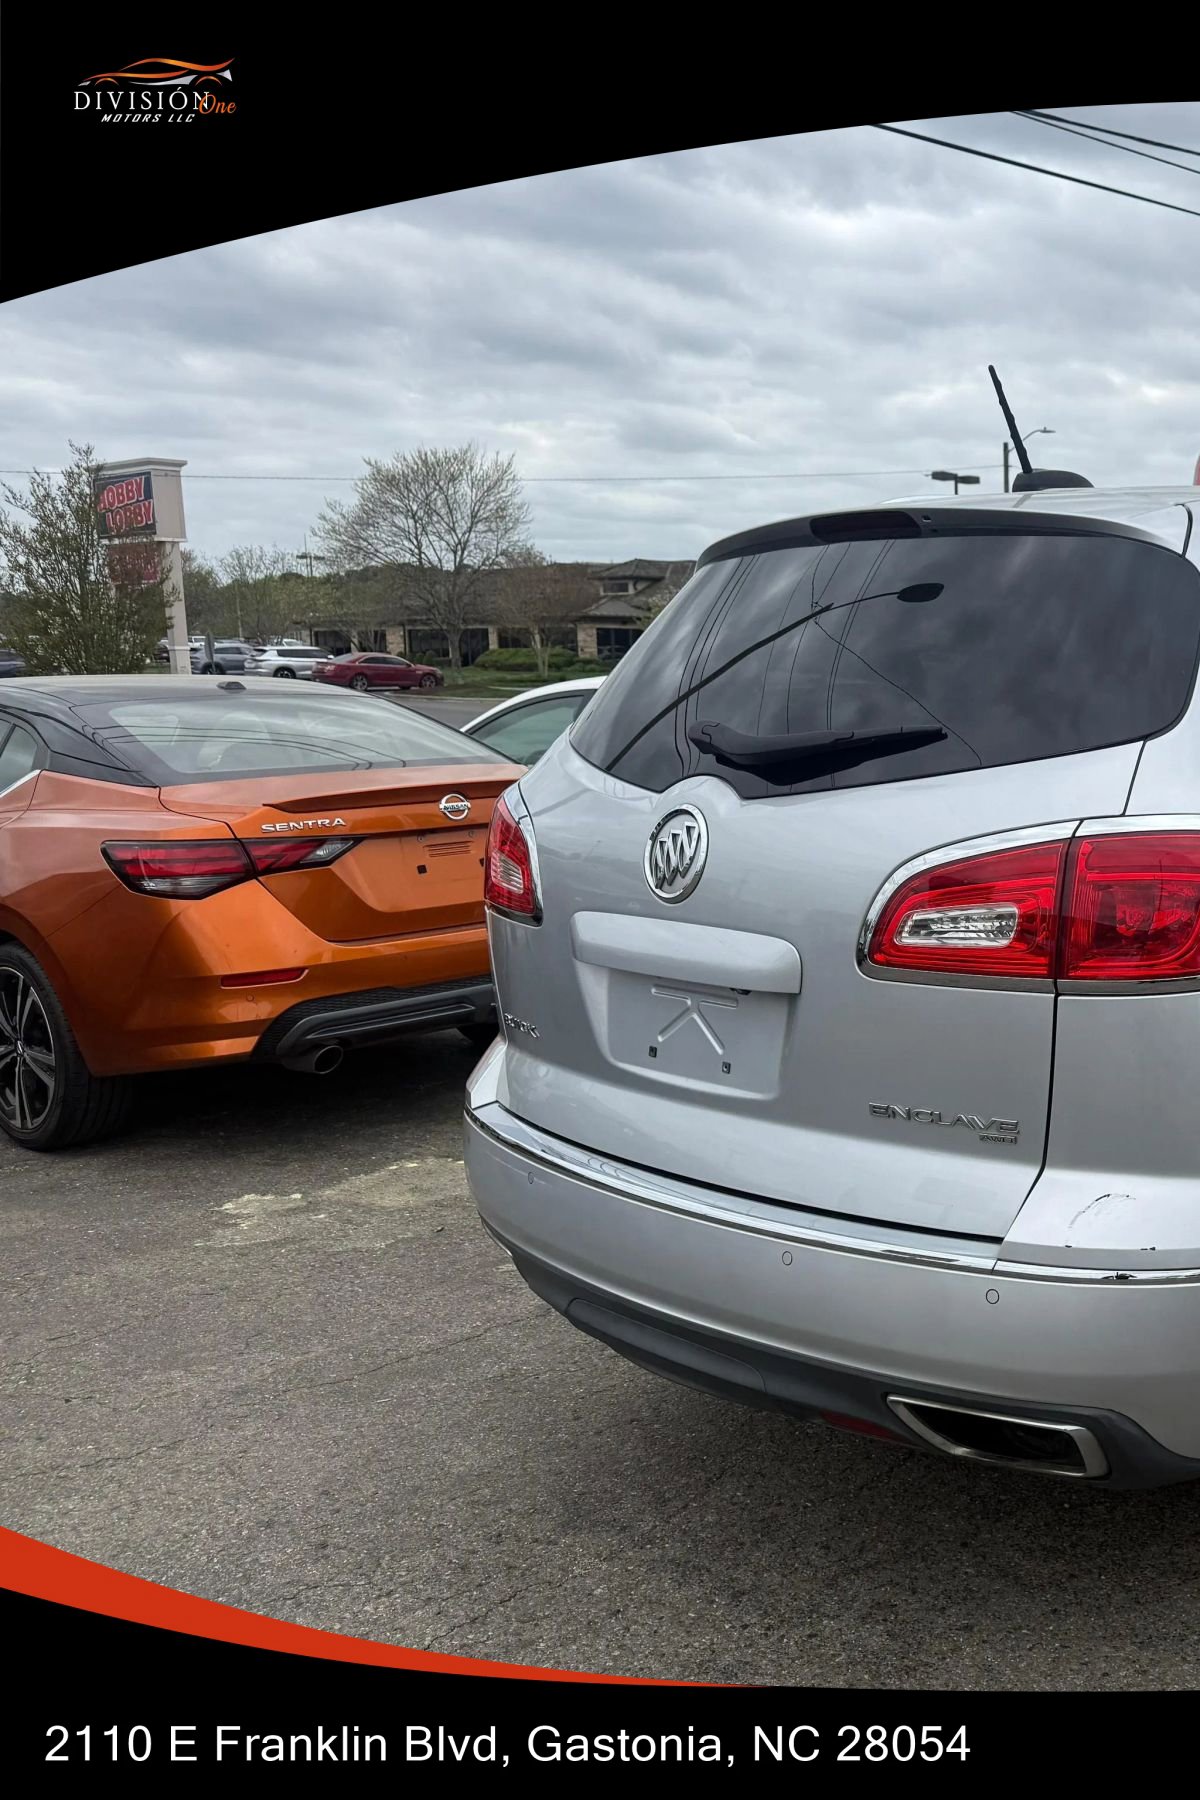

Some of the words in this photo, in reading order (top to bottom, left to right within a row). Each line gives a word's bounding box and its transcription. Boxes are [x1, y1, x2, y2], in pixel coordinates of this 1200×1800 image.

[106, 500, 153, 535] LOBBY
[261, 817, 347, 834] SENTRA
[868, 1102, 1020, 1135] ENCLAVE
